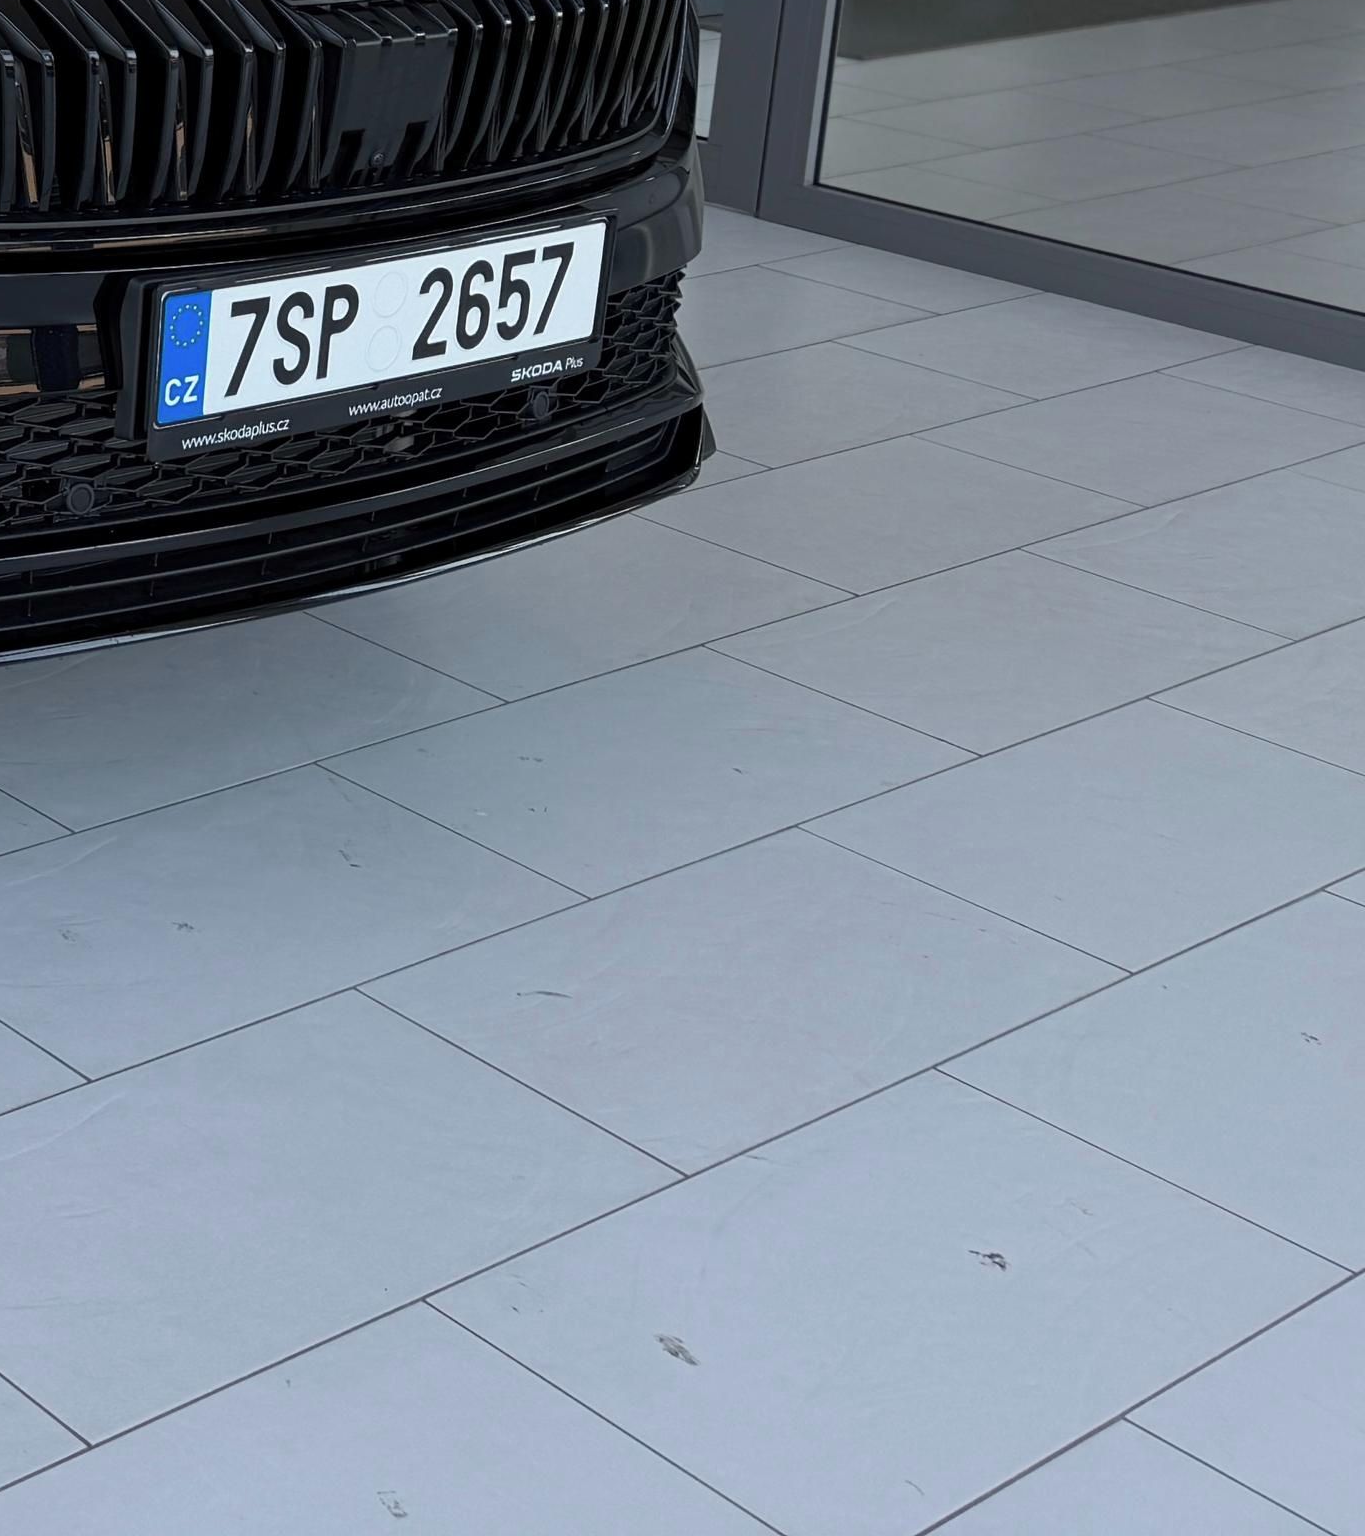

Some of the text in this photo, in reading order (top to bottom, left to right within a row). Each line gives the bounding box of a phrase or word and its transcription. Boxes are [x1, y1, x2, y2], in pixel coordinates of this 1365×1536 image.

[224, 241, 575, 398] 7SP 2657
[163, 373, 200, 407] CZ
[348, 386, 443, 417] www.autoopat.cz
[181, 418, 291, 450] www.skodaplus.cz
